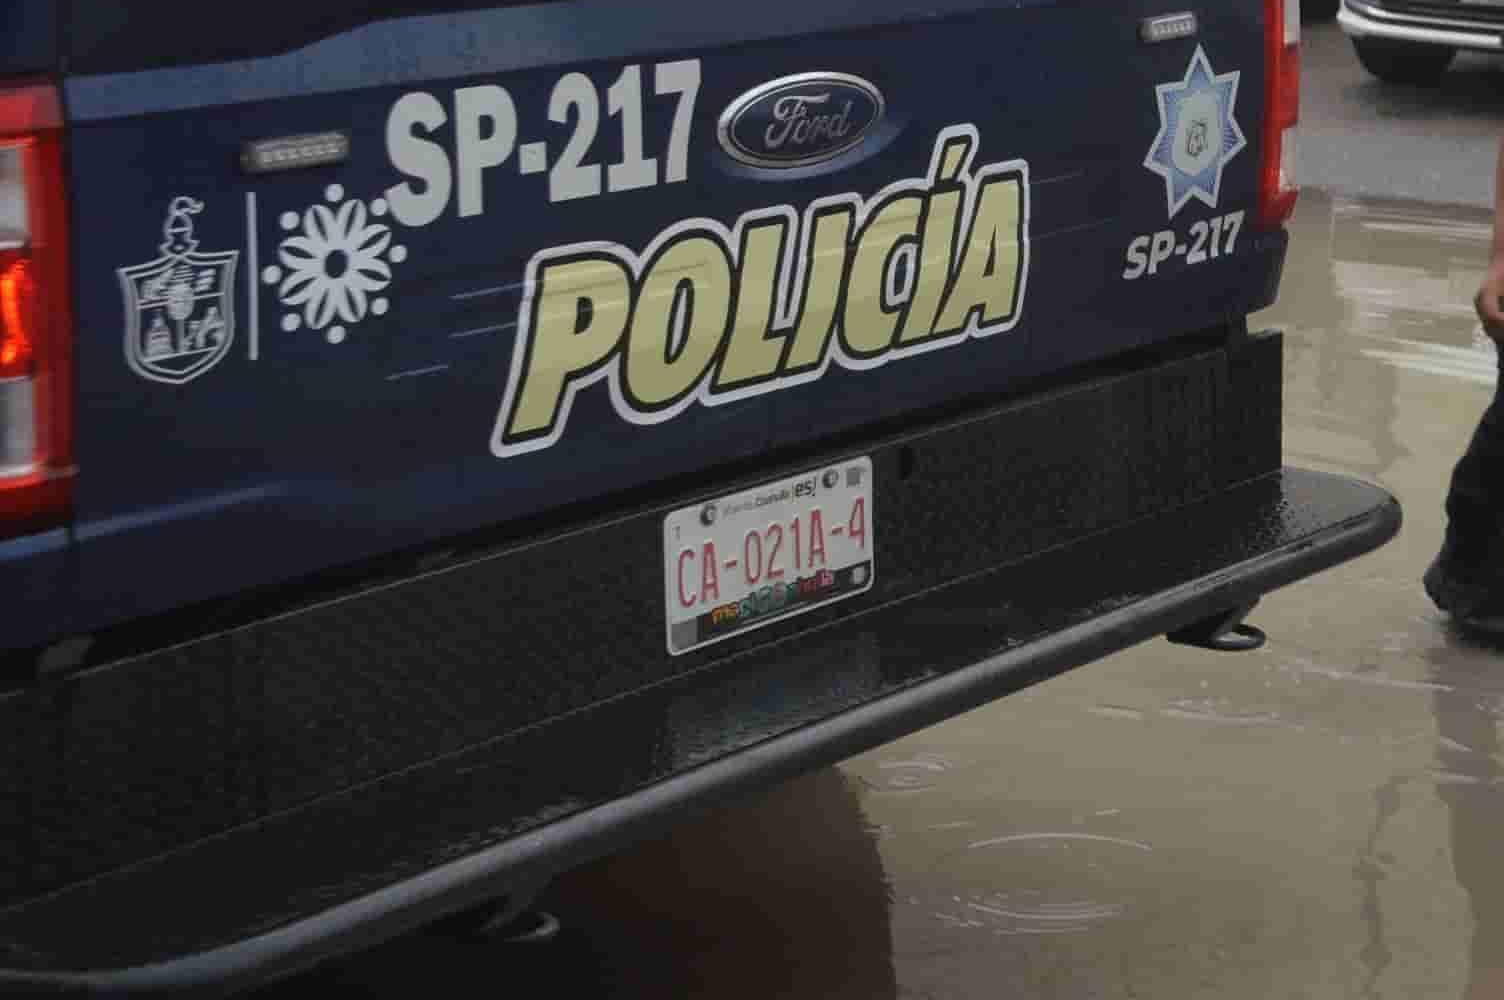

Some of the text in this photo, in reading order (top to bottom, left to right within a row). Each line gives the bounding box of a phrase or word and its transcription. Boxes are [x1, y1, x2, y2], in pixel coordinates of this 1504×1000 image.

[384, 58, 702, 227] SP-217
[765, 93, 854, 149] Ford
[490, 123, 1031, 458] POLICÍA
[1122, 209, 1246, 279] SP-217
[678, 496, 866, 608] CA-021A-4
